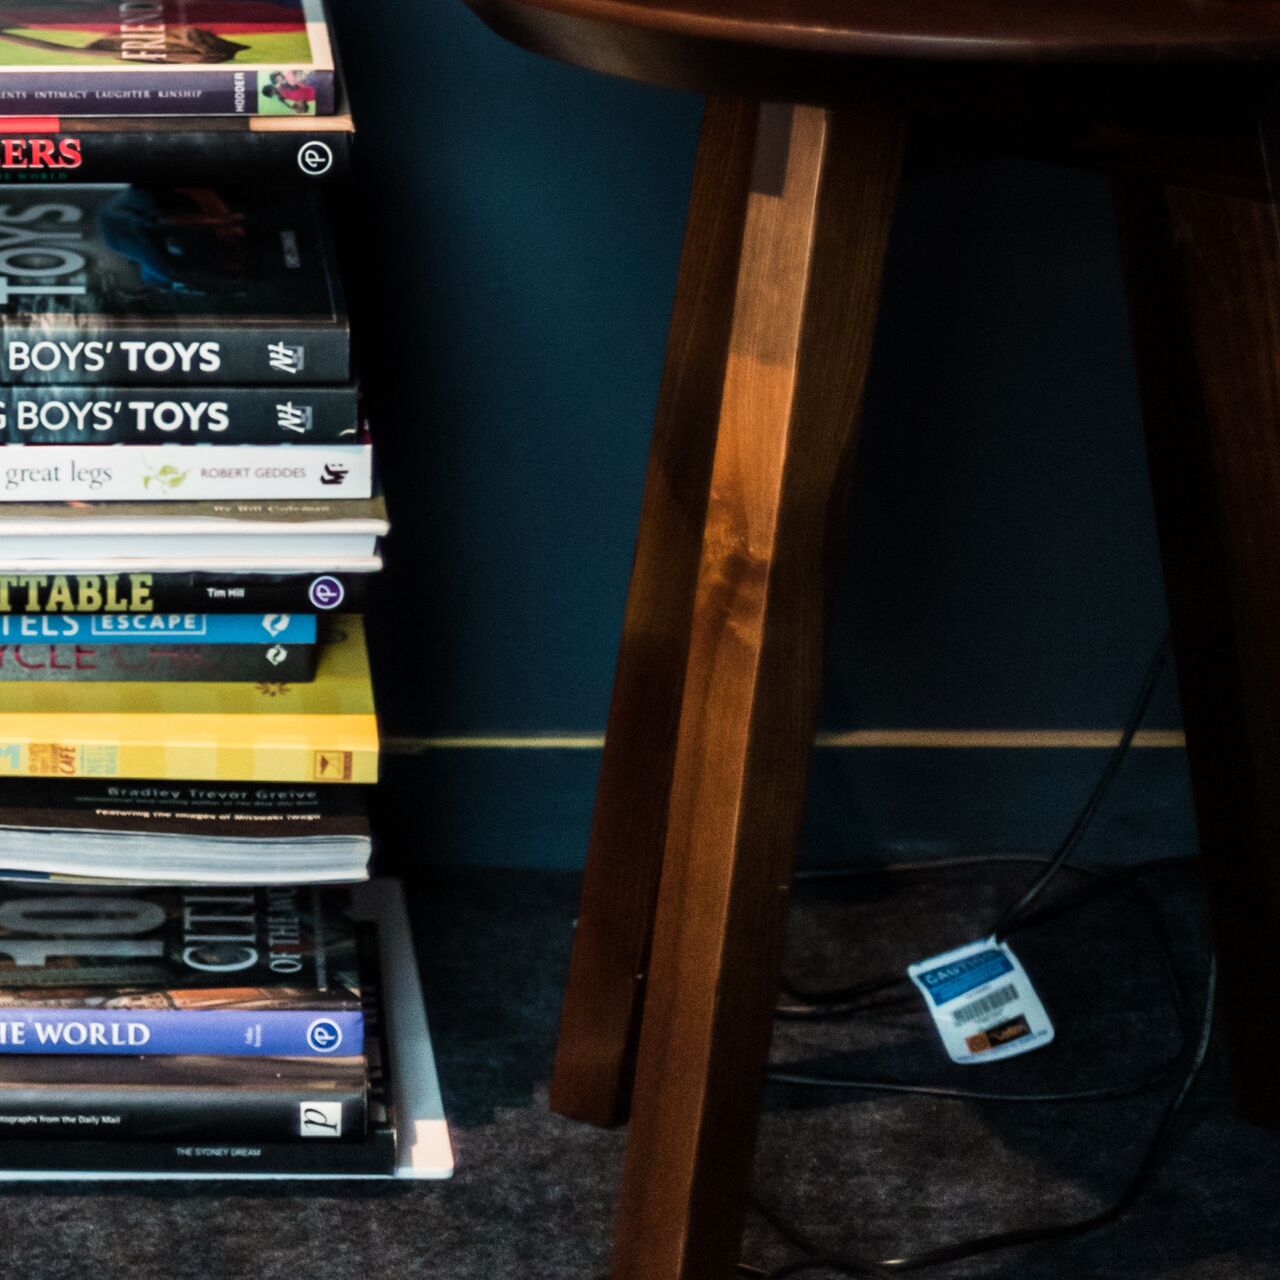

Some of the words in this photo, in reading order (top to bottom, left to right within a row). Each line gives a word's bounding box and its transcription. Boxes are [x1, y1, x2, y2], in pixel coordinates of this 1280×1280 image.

[34, 90, 88, 99] INTIMACY
[95, 90, 150, 99] LAUGHTER
[158, 89, 202, 98] KINSHIP
[234, 72, 245, 113] HODDER
[8, 341, 113, 371] BOYS'
[120, 341, 221, 372] TOYS
[17, 401, 122, 431] BOYS'
[128, 401, 230, 432] TOYS
[5, 465, 61, 490] great
[71, 460, 112, 489] legs
[200, 468, 250, 478] ROBERT
[255, 467, 306, 478] GEDDES
[206, 588, 226, 598] Tim
[228, 588, 245, 598] Hill
[101, 614, 196, 630] ESCAPE
[107, 787, 181, 800] Bradley
[189, 788, 248, 800] Trevor
[255, 789, 317, 800] Greive
[183, 895, 258, 972] CITI
[34, 1022, 151, 1046] WORLD
[40, 1115, 61, 1124] from
[62, 1115, 76, 1124] the
[78, 1115, 99, 1126] Daily
[102, 1115, 121, 1124] Mail
[177, 1147, 192, 1157] THE
[195, 1147, 229, 1157] SYDNEY
